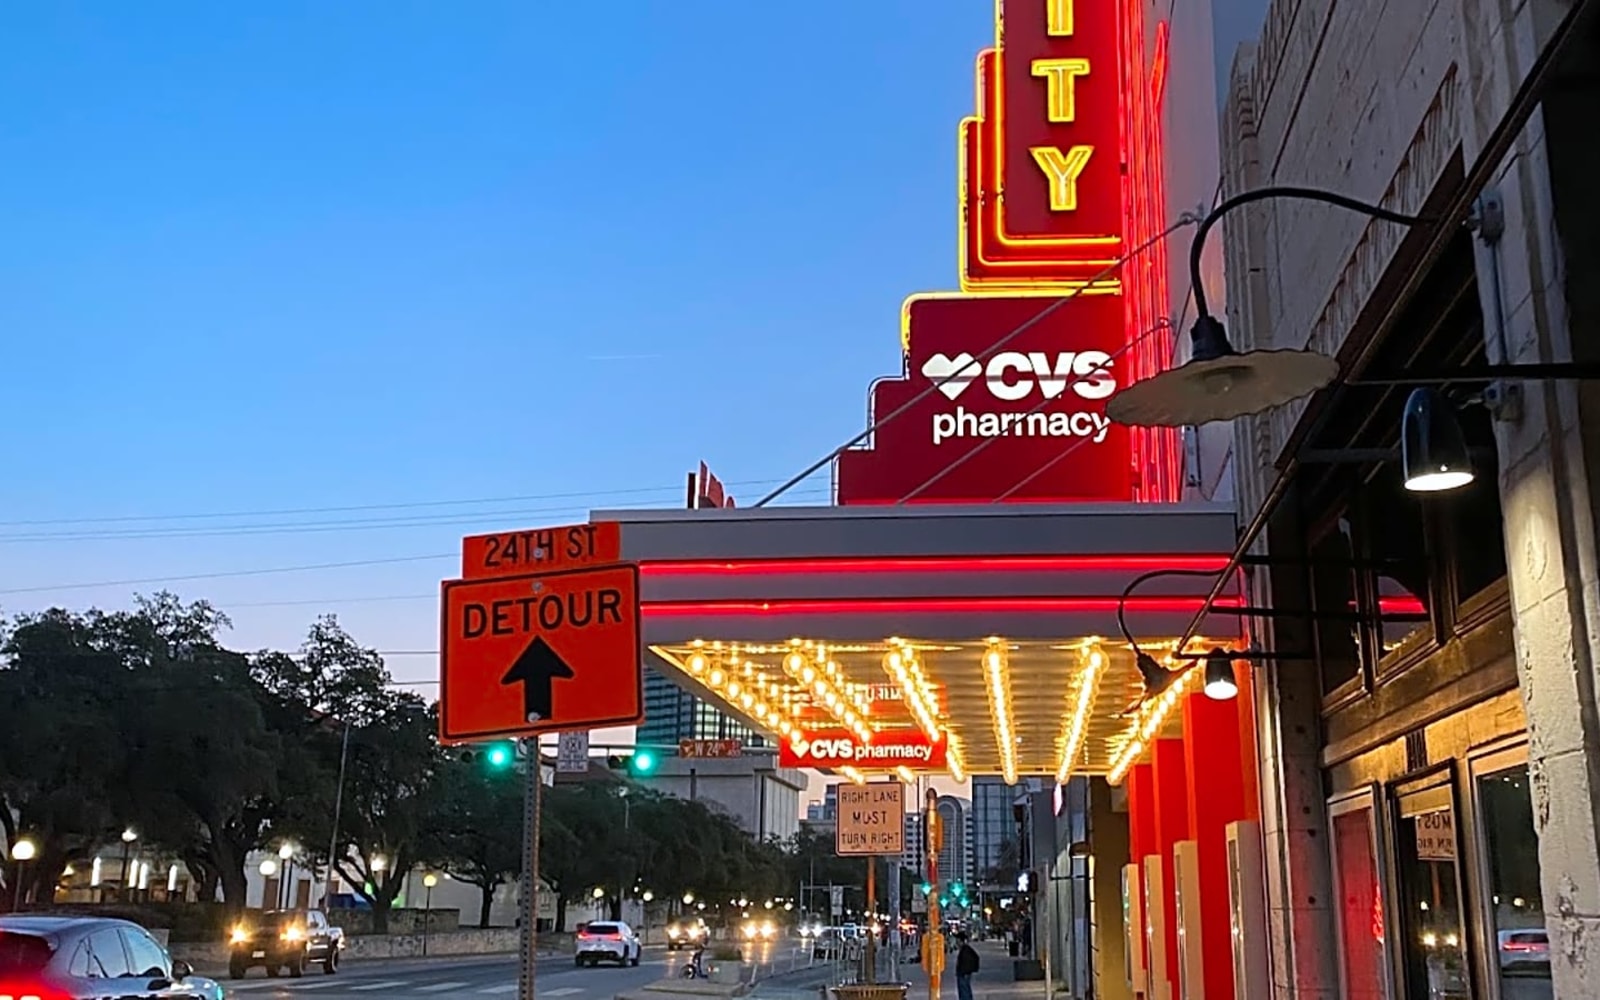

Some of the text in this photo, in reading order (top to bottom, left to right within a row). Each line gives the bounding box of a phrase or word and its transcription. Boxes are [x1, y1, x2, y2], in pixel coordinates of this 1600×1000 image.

[985, 350, 1117, 400] CVS
[933, 406, 1111, 445] pharmacy
[485, 526, 597, 567] 24TH ST
[463, 589, 622, 638] DETOUR
[810, 739, 932, 761] CVS pharmacy
[841, 790, 898, 803] RIGHT LANE
[853, 810, 887, 825] MUST
[841, 832, 899, 844] TURN RIGHT
